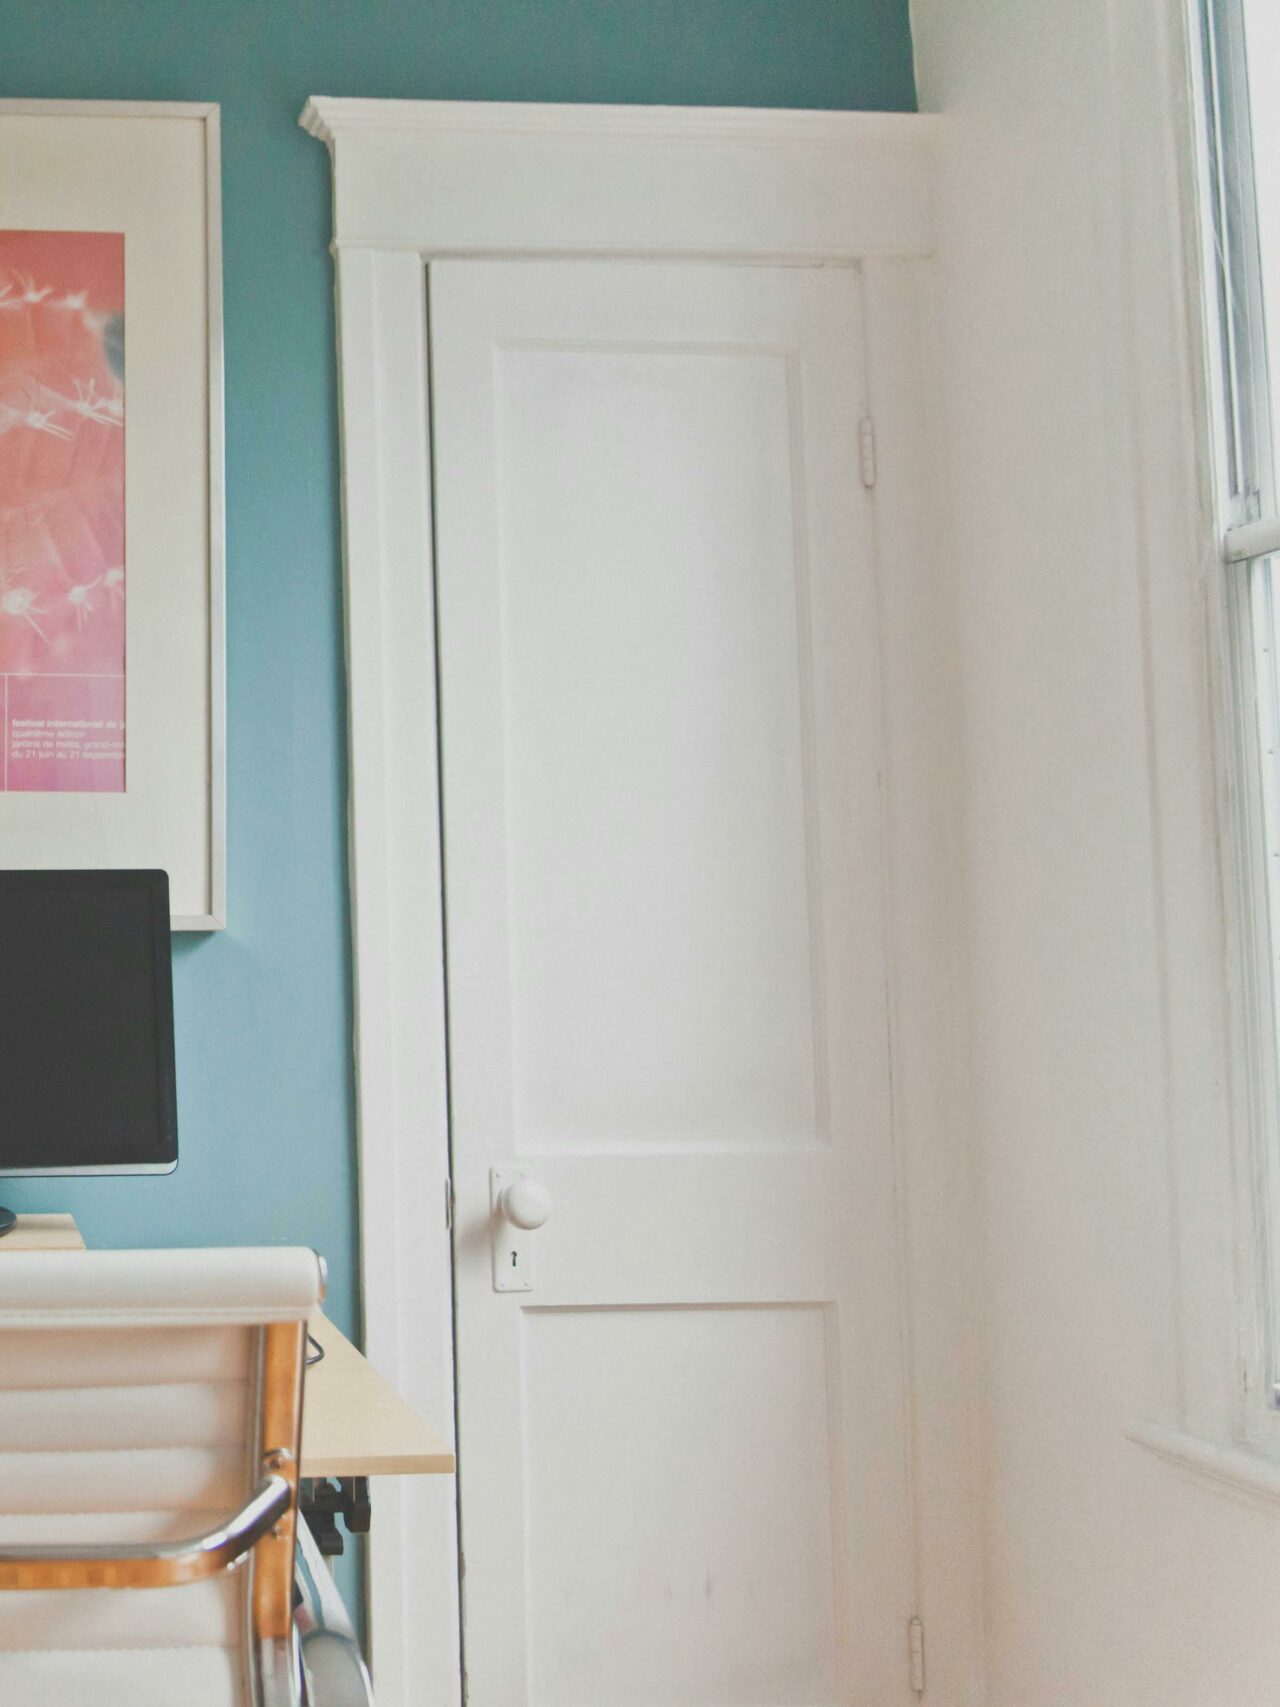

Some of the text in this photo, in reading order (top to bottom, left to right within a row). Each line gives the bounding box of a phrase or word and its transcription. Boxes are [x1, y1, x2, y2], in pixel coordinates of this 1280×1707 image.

[13, 719, 44, 728] festival
[46, 720, 103, 729] international
[106, 721, 117, 729] de
